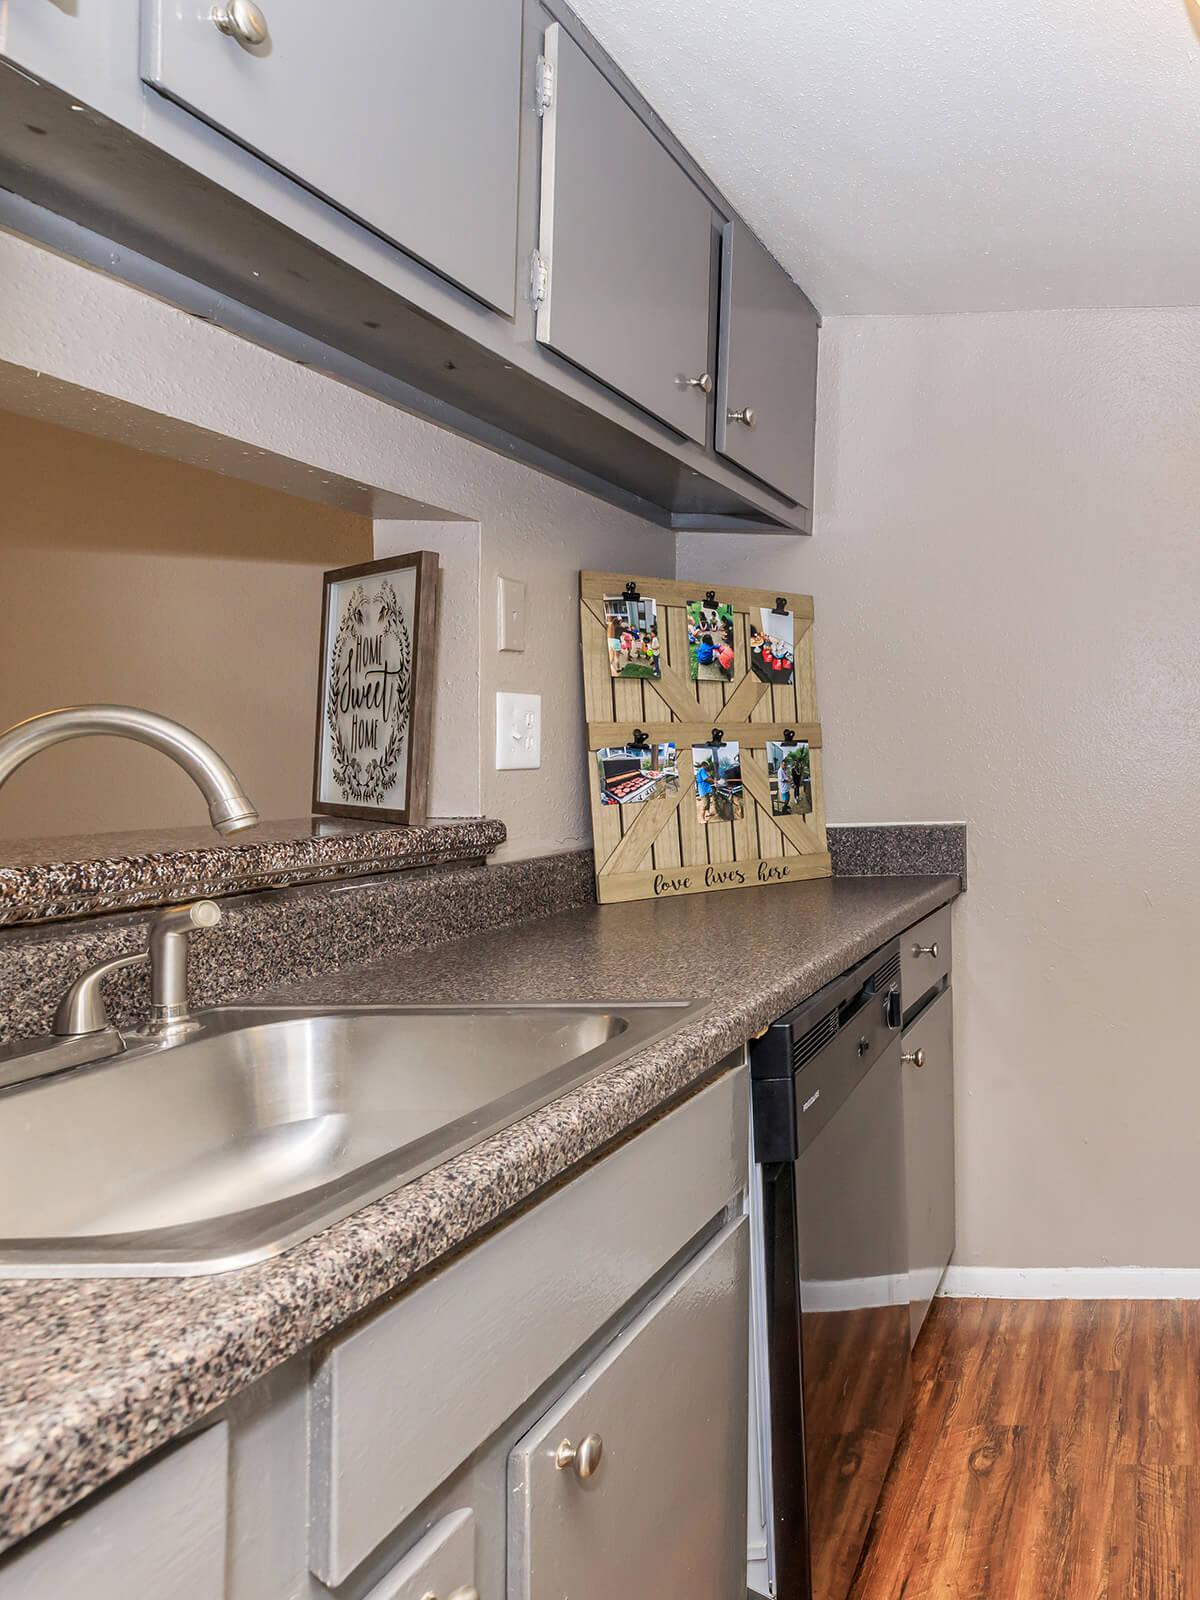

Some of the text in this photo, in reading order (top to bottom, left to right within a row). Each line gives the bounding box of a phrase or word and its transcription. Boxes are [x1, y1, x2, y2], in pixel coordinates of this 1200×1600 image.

[355, 634, 383, 673] HOME
[340, 647, 403, 723] Sweet
[350, 714, 378, 754] HOME
[653, 862, 791, 895] love lives here
